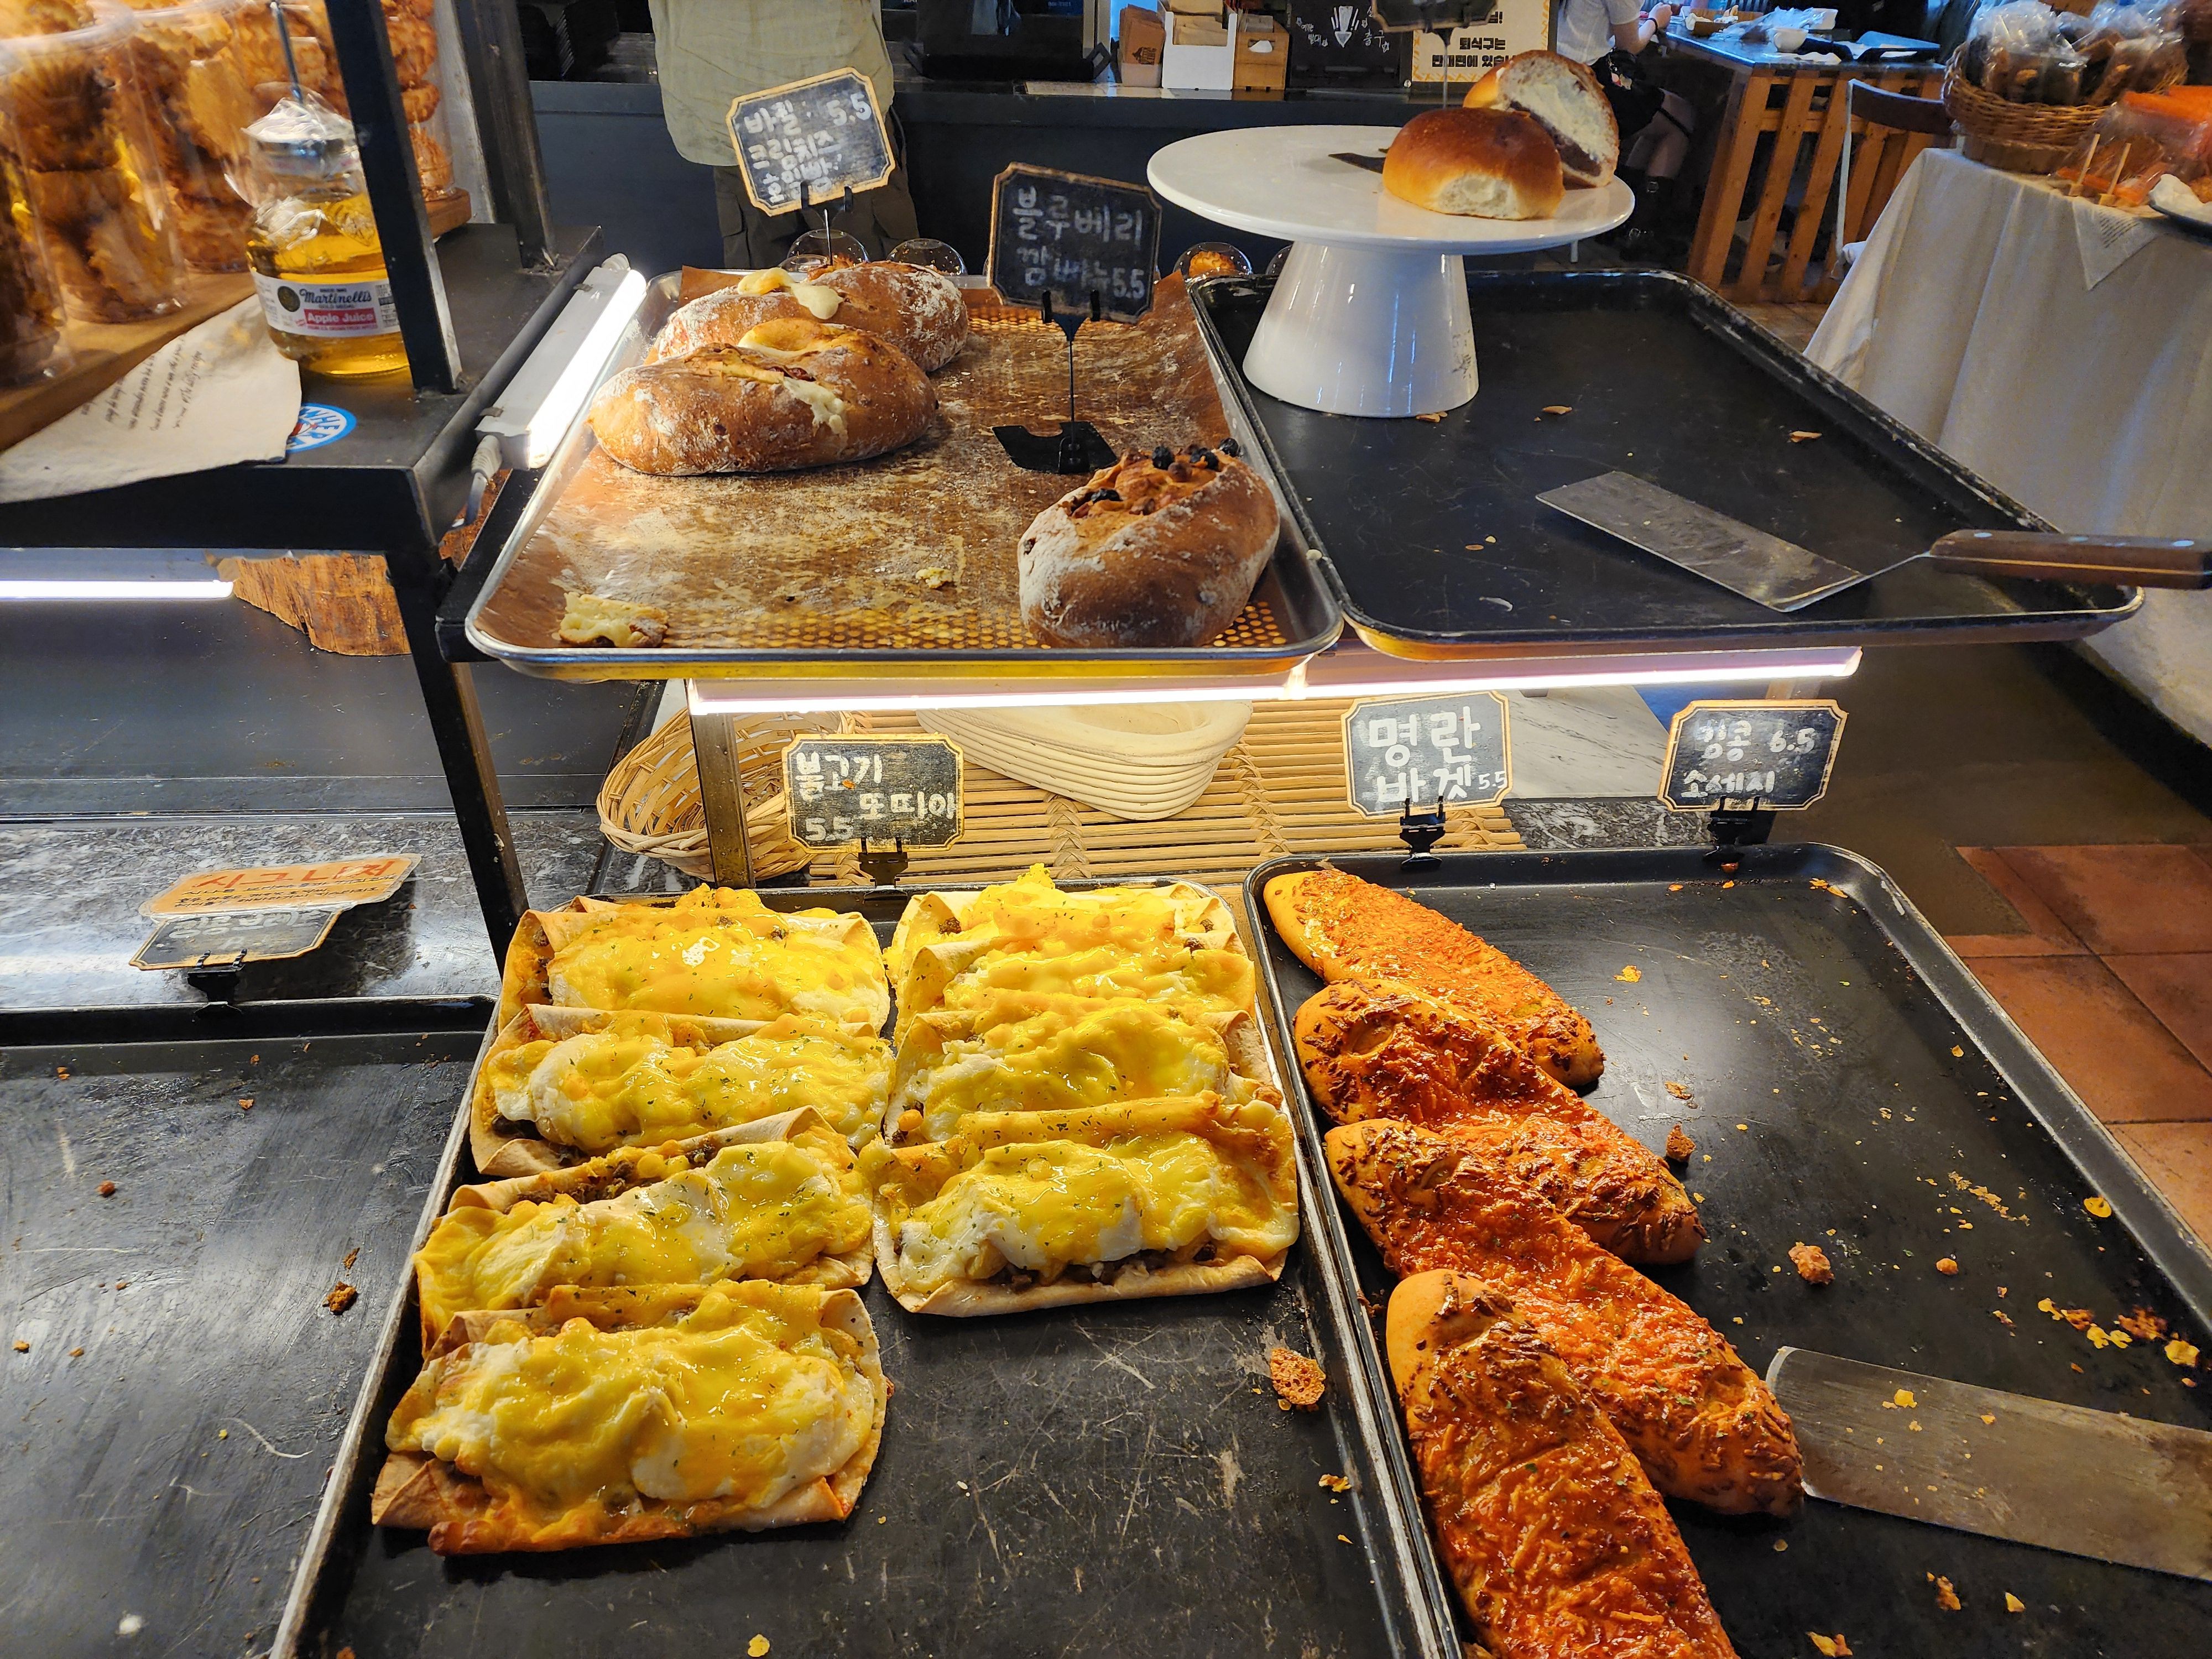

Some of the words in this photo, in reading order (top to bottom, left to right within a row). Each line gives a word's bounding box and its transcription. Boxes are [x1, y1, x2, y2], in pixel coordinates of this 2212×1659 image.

[1459, 37, 1506, 50] 퇴식구는
[826, 93, 872, 126] 5.5
[1013, 186, 1143, 246] 블루베리
[1113, 268, 1145, 299] 5.5
[307, 313, 339, 324] Apple
[343, 313, 373, 321] Juice
[1369, 706, 1481, 768] 명란
[1770, 727, 1815, 754] 6.5
[795, 752, 883, 802] 불고기
[1376, 764, 1472, 803] 바겟
[1478, 770, 1507, 790] 5.5
[1681, 769, 1776, 798] 소세지
[805, 816, 854, 841] 5.5
